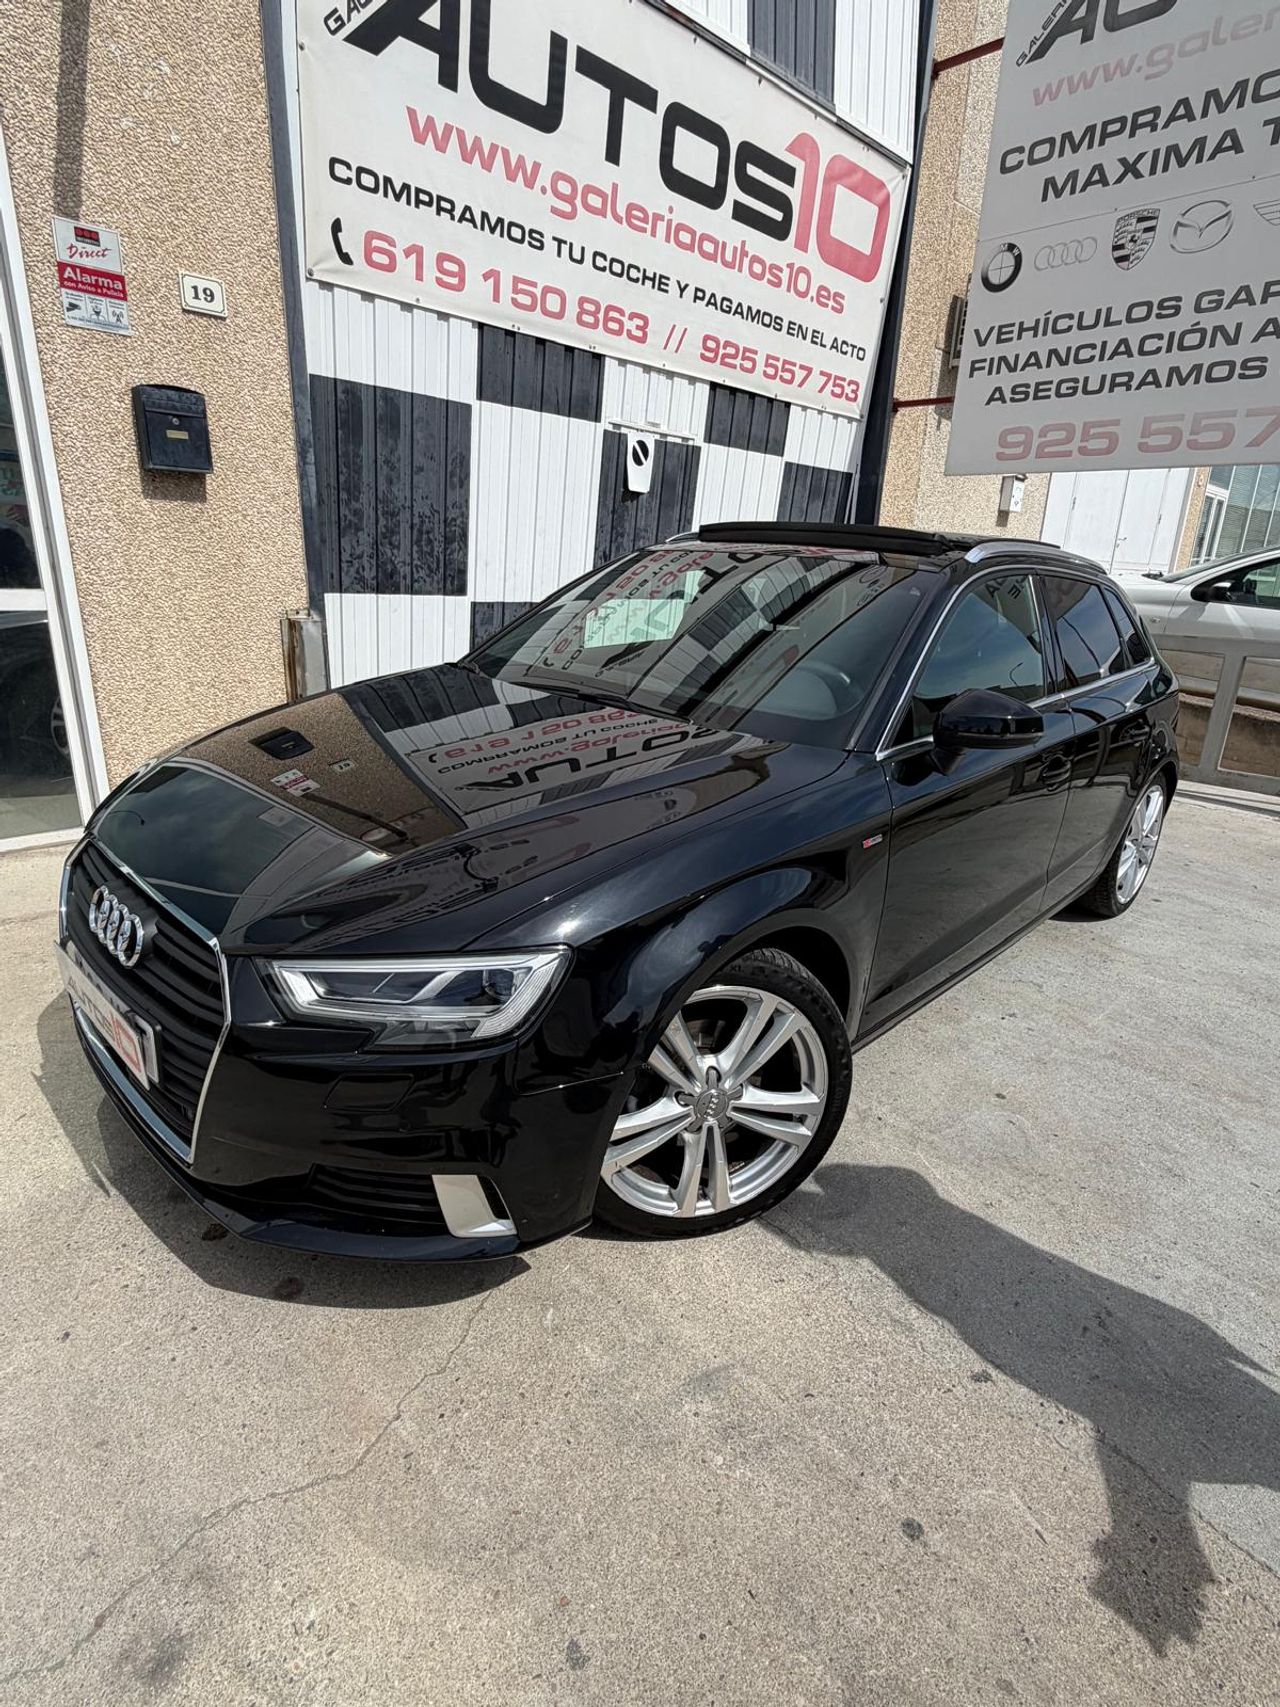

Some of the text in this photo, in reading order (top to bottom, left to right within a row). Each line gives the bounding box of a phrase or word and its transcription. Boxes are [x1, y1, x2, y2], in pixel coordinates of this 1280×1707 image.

[1041, 127, 1245, 203] MAXIMA
[406, 105, 846, 315] www.galeriaautos10.es
[63, 266, 123, 291] Alarma
[66, 242, 112, 259] Direct
[328, 156, 867, 362] COMPRAMOS TU COCHE Y PAGAMOS EN EL ACTO
[191, 285, 215, 303] 19
[363, 230, 466, 292] 619
[482, 268, 567, 320] 150
[576, 295, 650, 344] 863
[699, 333, 758, 375] 925
[762, 353, 813, 388] 557
[818, 370, 861, 403] 753
[973, 295, 1183, 347] VEHÍCULOS
[968, 320, 1243, 379] FINANCIACIÓN
[985, 355, 1269, 406] ASEGURAMOS
[995, 405, 1280, 462] 925 557
